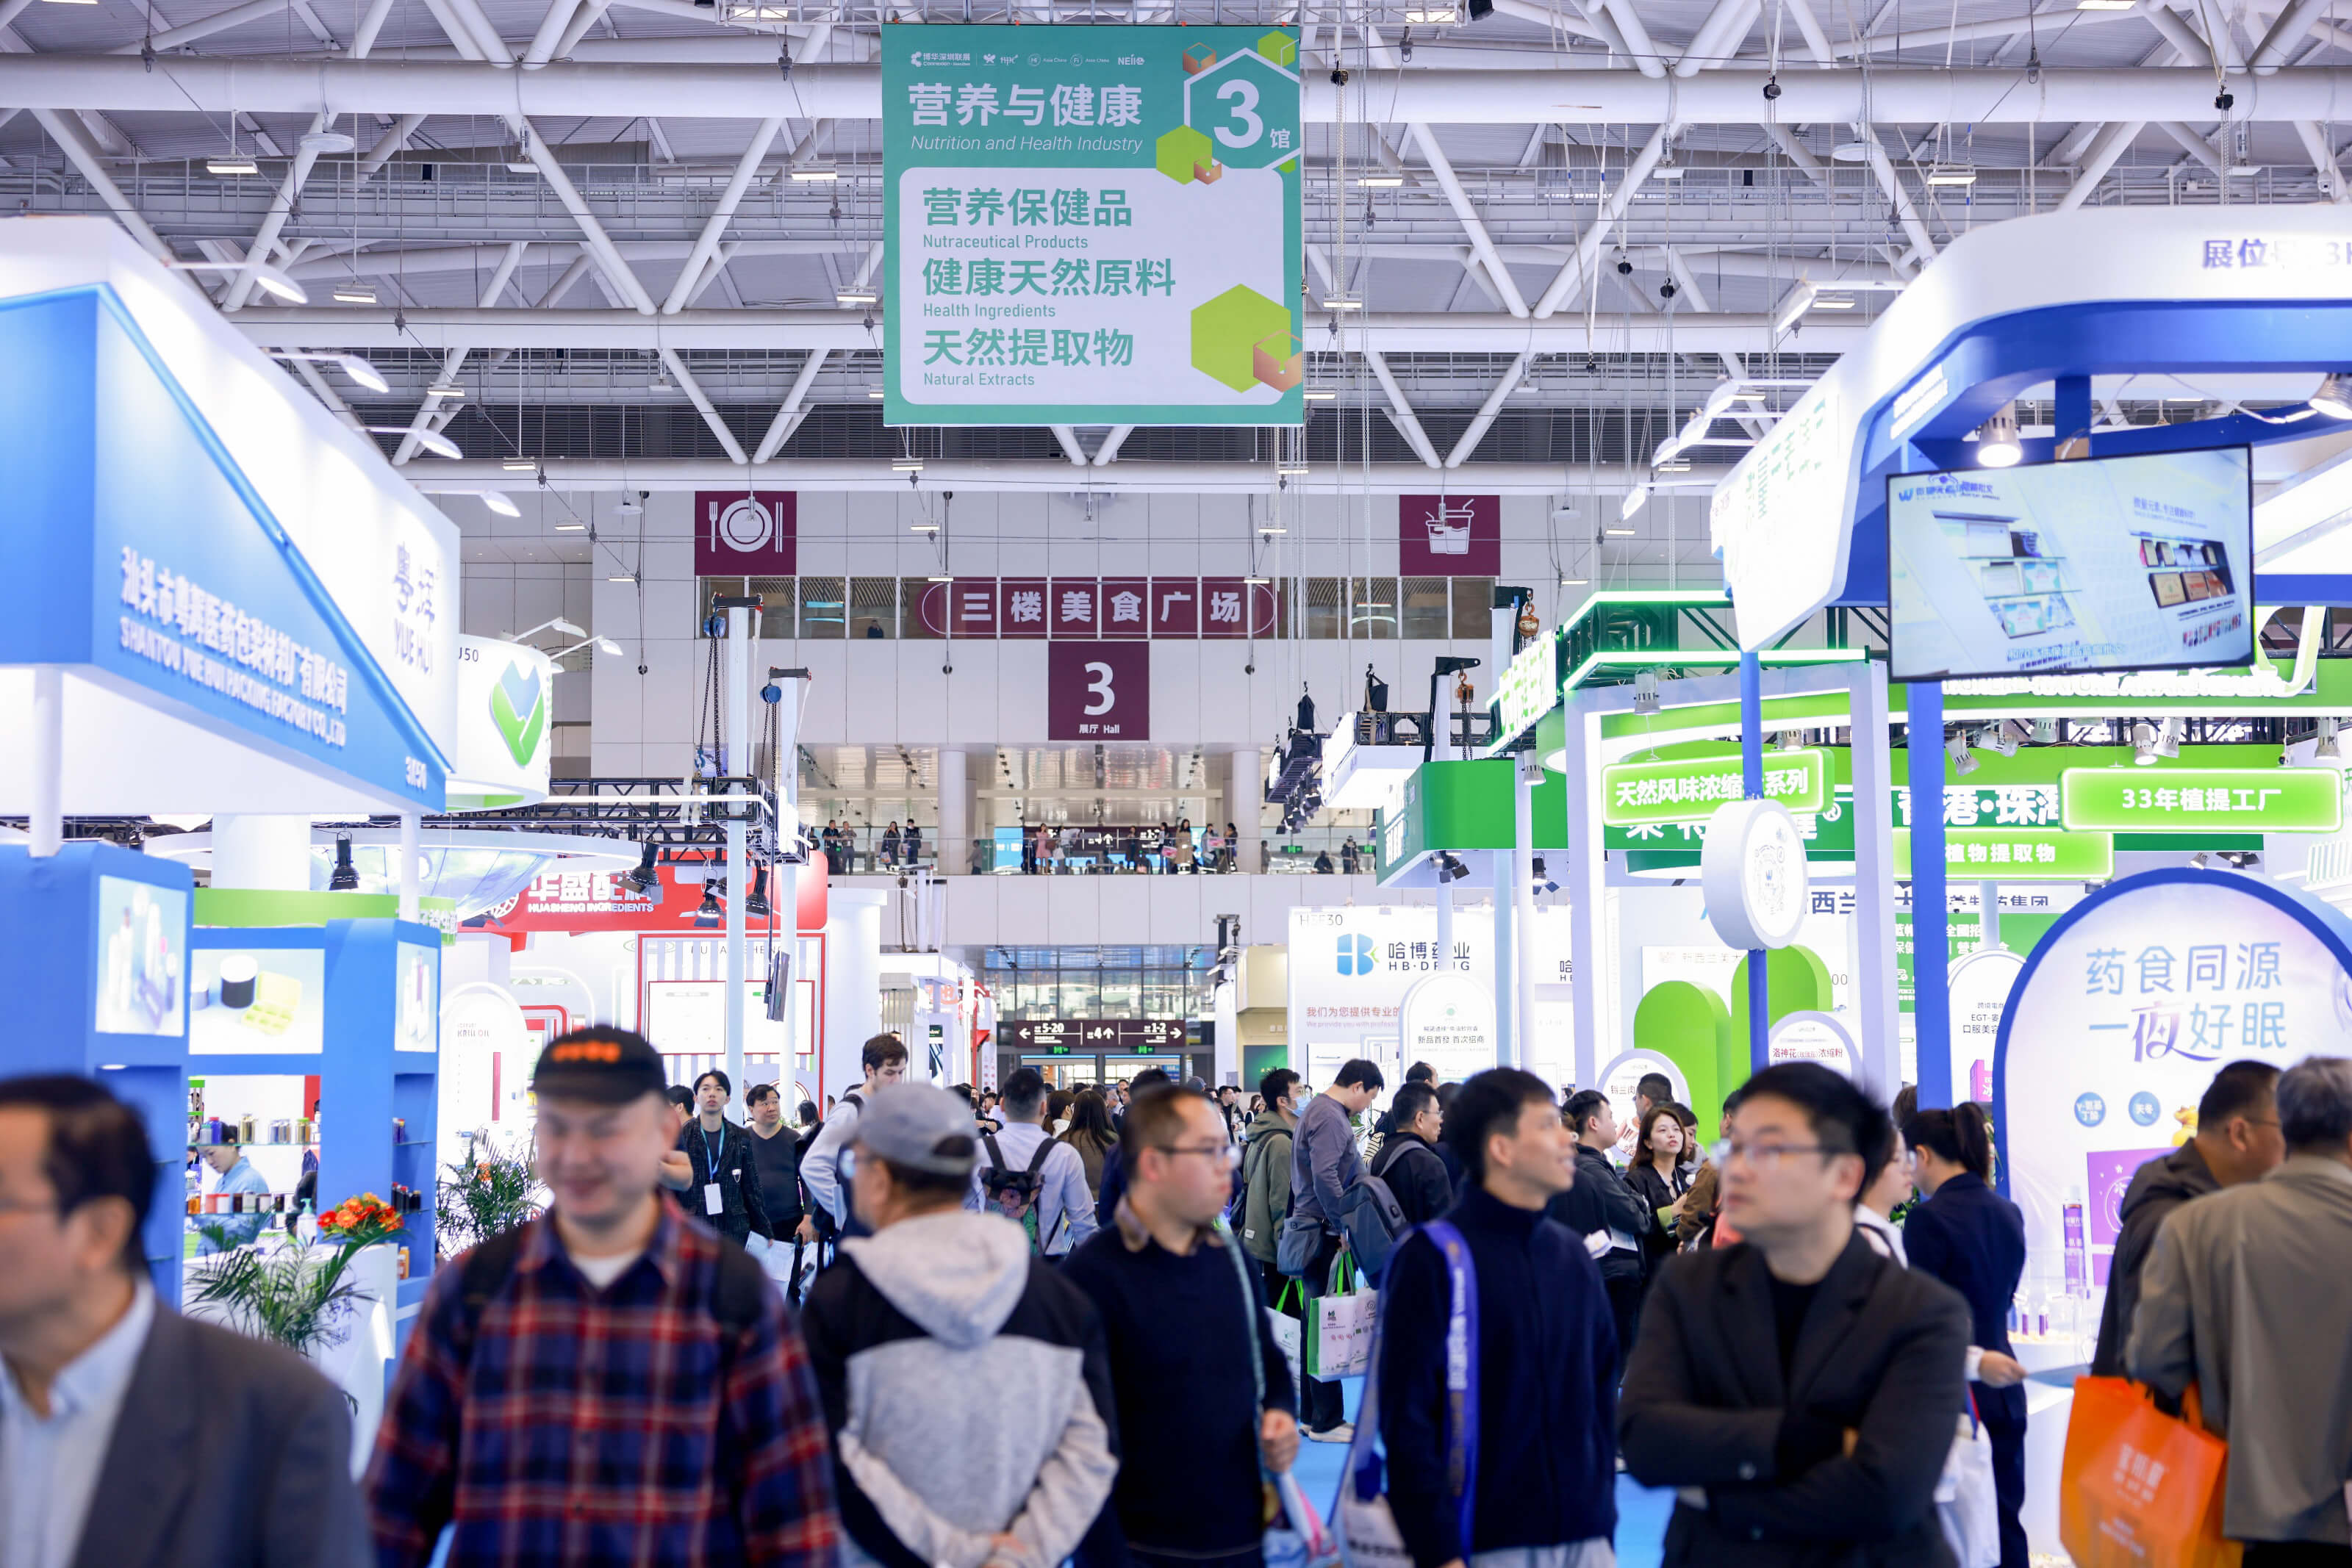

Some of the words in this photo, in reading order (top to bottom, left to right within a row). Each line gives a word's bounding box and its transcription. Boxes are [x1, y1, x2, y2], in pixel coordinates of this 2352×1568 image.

[908, 82, 1142, 127] 营养与健康
[1213, 79, 1263, 148] 3
[911, 134, 980, 151] Nutrition
[985, 135, 1016, 151] and
[1020, 135, 1072, 151] Health
[1078, 136, 1143, 154] Industry
[1270, 128, 1291, 149] 馆
[923, 188, 1132, 226] 营养保健品
[923, 234, 1020, 248] Nutraceutical
[1025, 235, 1089, 248] Products
[922, 257, 1176, 296] 健康天然原料
[923, 303, 969, 317] Health
[975, 304, 1056, 320] Ingredients
[923, 328, 1133, 366] 天然提取物
[924, 373, 975, 386] Natural
[979, 373, 1035, 386] Extracts
[961, 591, 1241, 624] 三楼美食广场
[1084, 661, 1116, 716] 3
[1079, 724, 1099, 735] 展厅
[1104, 724, 1120, 735] Hall
[1616, 767, 1809, 807] 天然风味浓缩系列
[2122, 788, 2282, 811] 33年植提工厂
[1945, 844, 2057, 863] 植物提取物
[528, 871, 654, 902] 华盛配
[528, 903, 586, 913] HUASHENG
[587, 902, 654, 913] INGREDIENTS
[2086, 941, 2282, 996] 药食同源
[1306, 1006, 1400, 1018] 我们为您提供专业的
[1042, 1023, 1065, 1033] 5-20
[1151, 1023, 1166, 1033] 1-2
[2089, 1001, 2287, 1062] 一夜好眠
